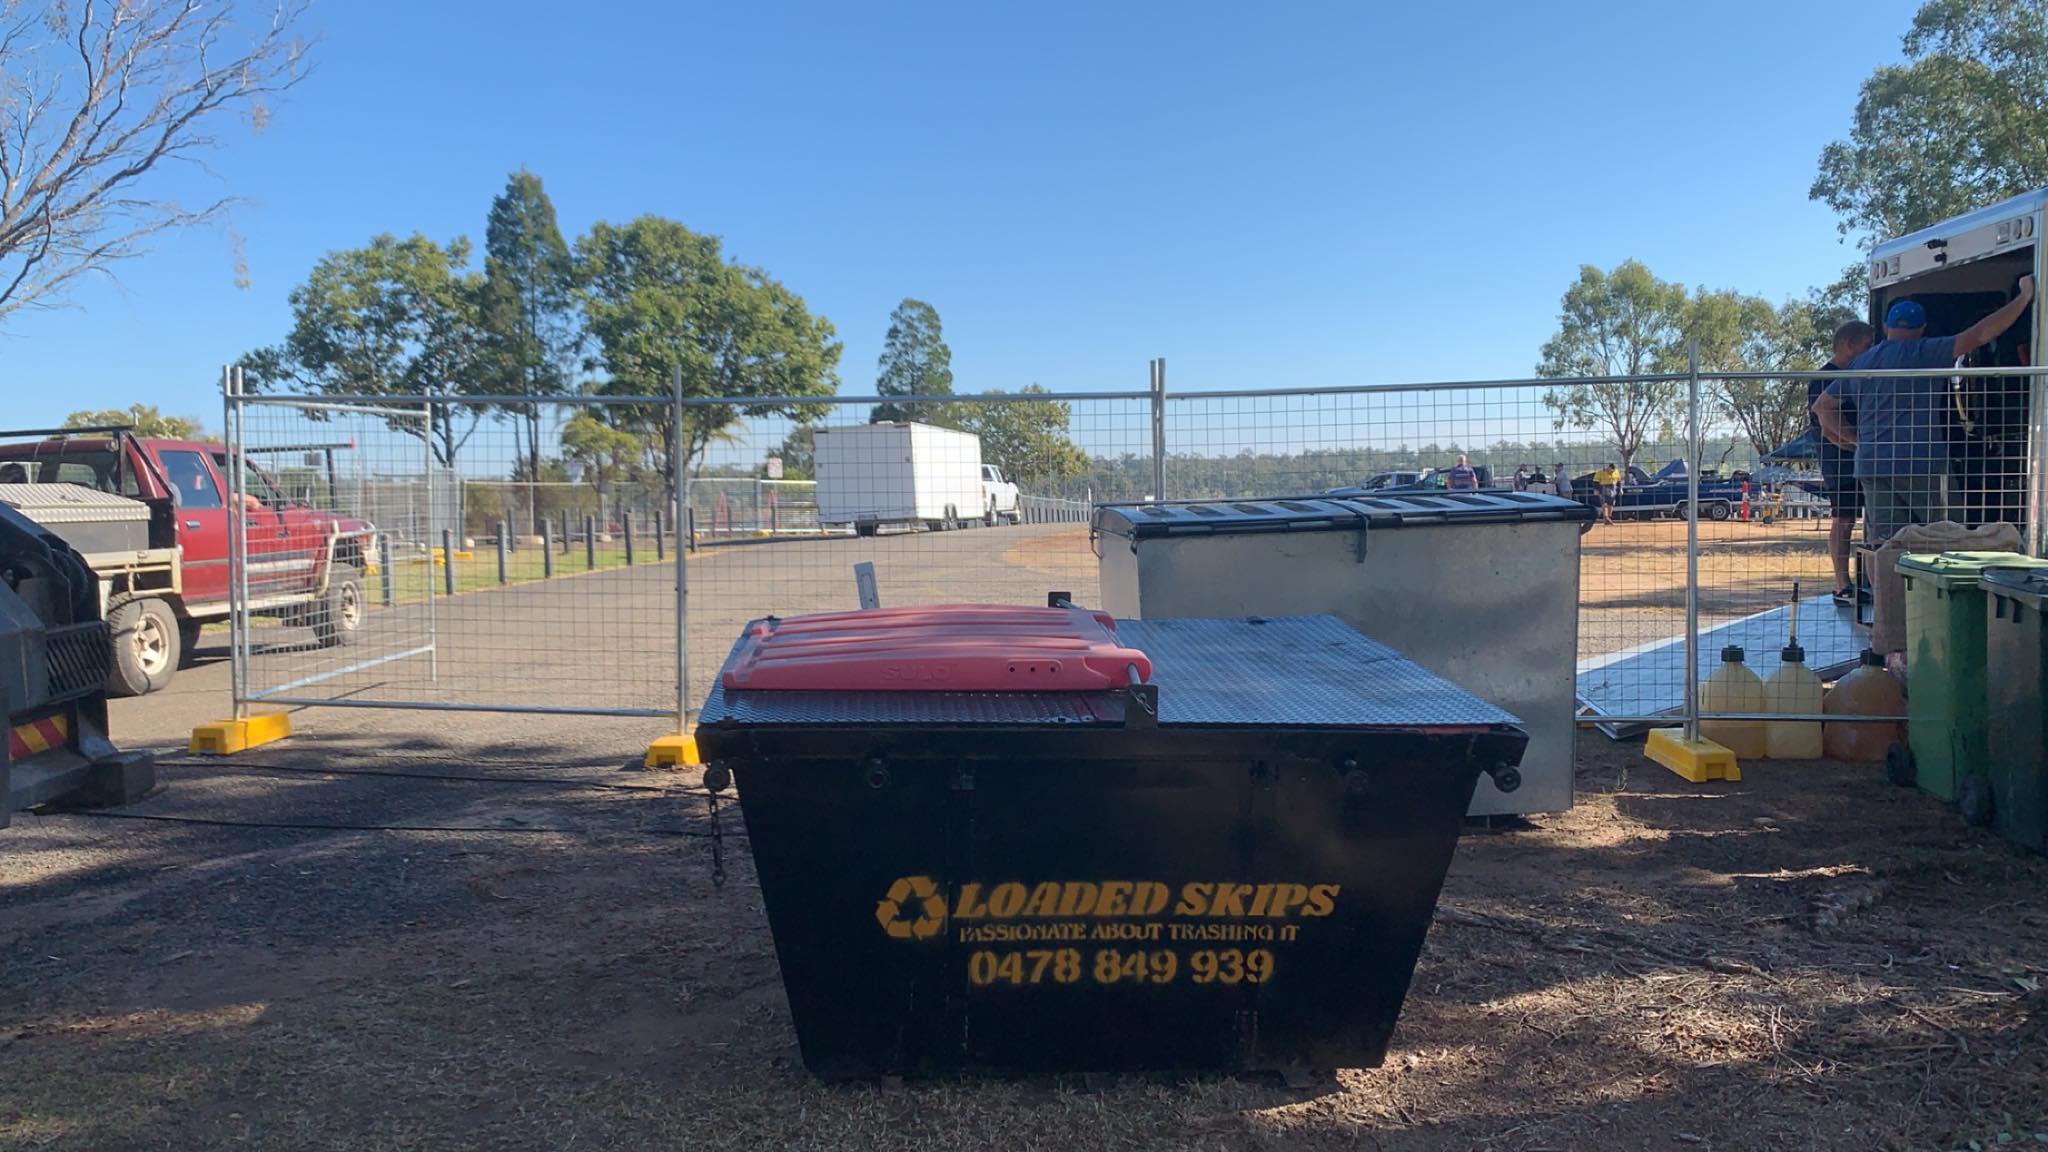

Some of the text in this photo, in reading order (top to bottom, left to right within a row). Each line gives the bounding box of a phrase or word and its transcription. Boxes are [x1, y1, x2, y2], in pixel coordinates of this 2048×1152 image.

[880, 663, 953, 682] SULO
[953, 882, 1341, 918] LOADED SKIPS
[959, 924, 1300, 943] PASSIONATE ABOUT TRASHING IT
[970, 949, 1275, 985] 0478 849 939
